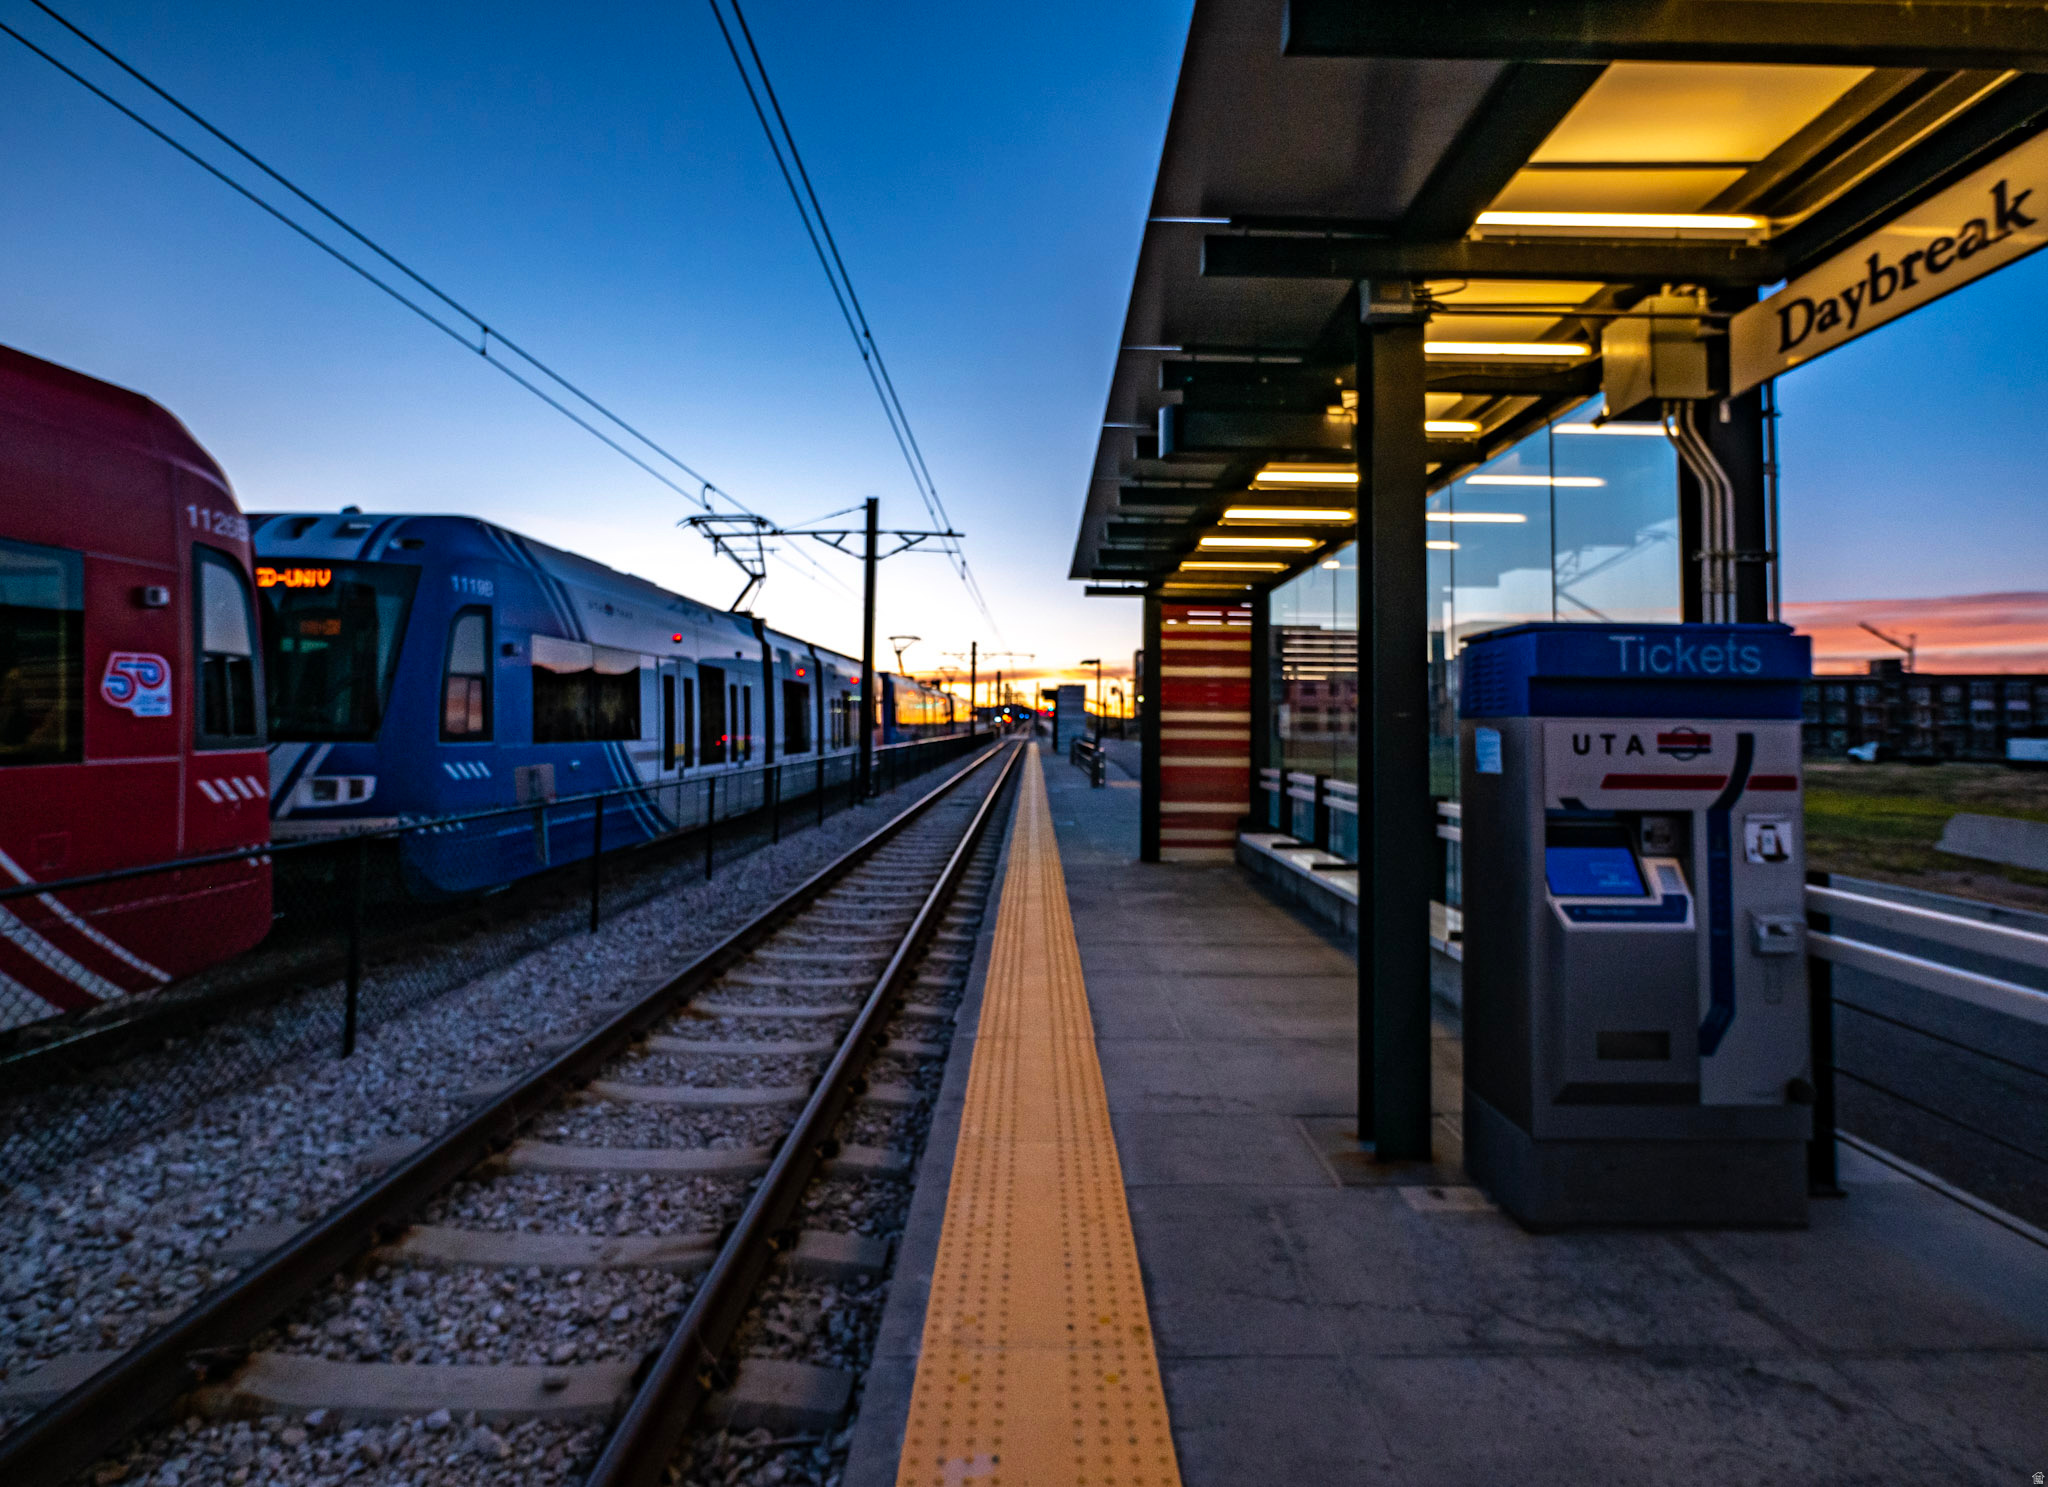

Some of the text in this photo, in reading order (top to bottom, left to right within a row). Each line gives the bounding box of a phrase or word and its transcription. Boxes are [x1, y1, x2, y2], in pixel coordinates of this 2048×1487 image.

[1777, 179, 2037, 353] Daybreak
[1608, 633, 1761, 674] Tickets
[1573, 734, 1645, 756] UTA
